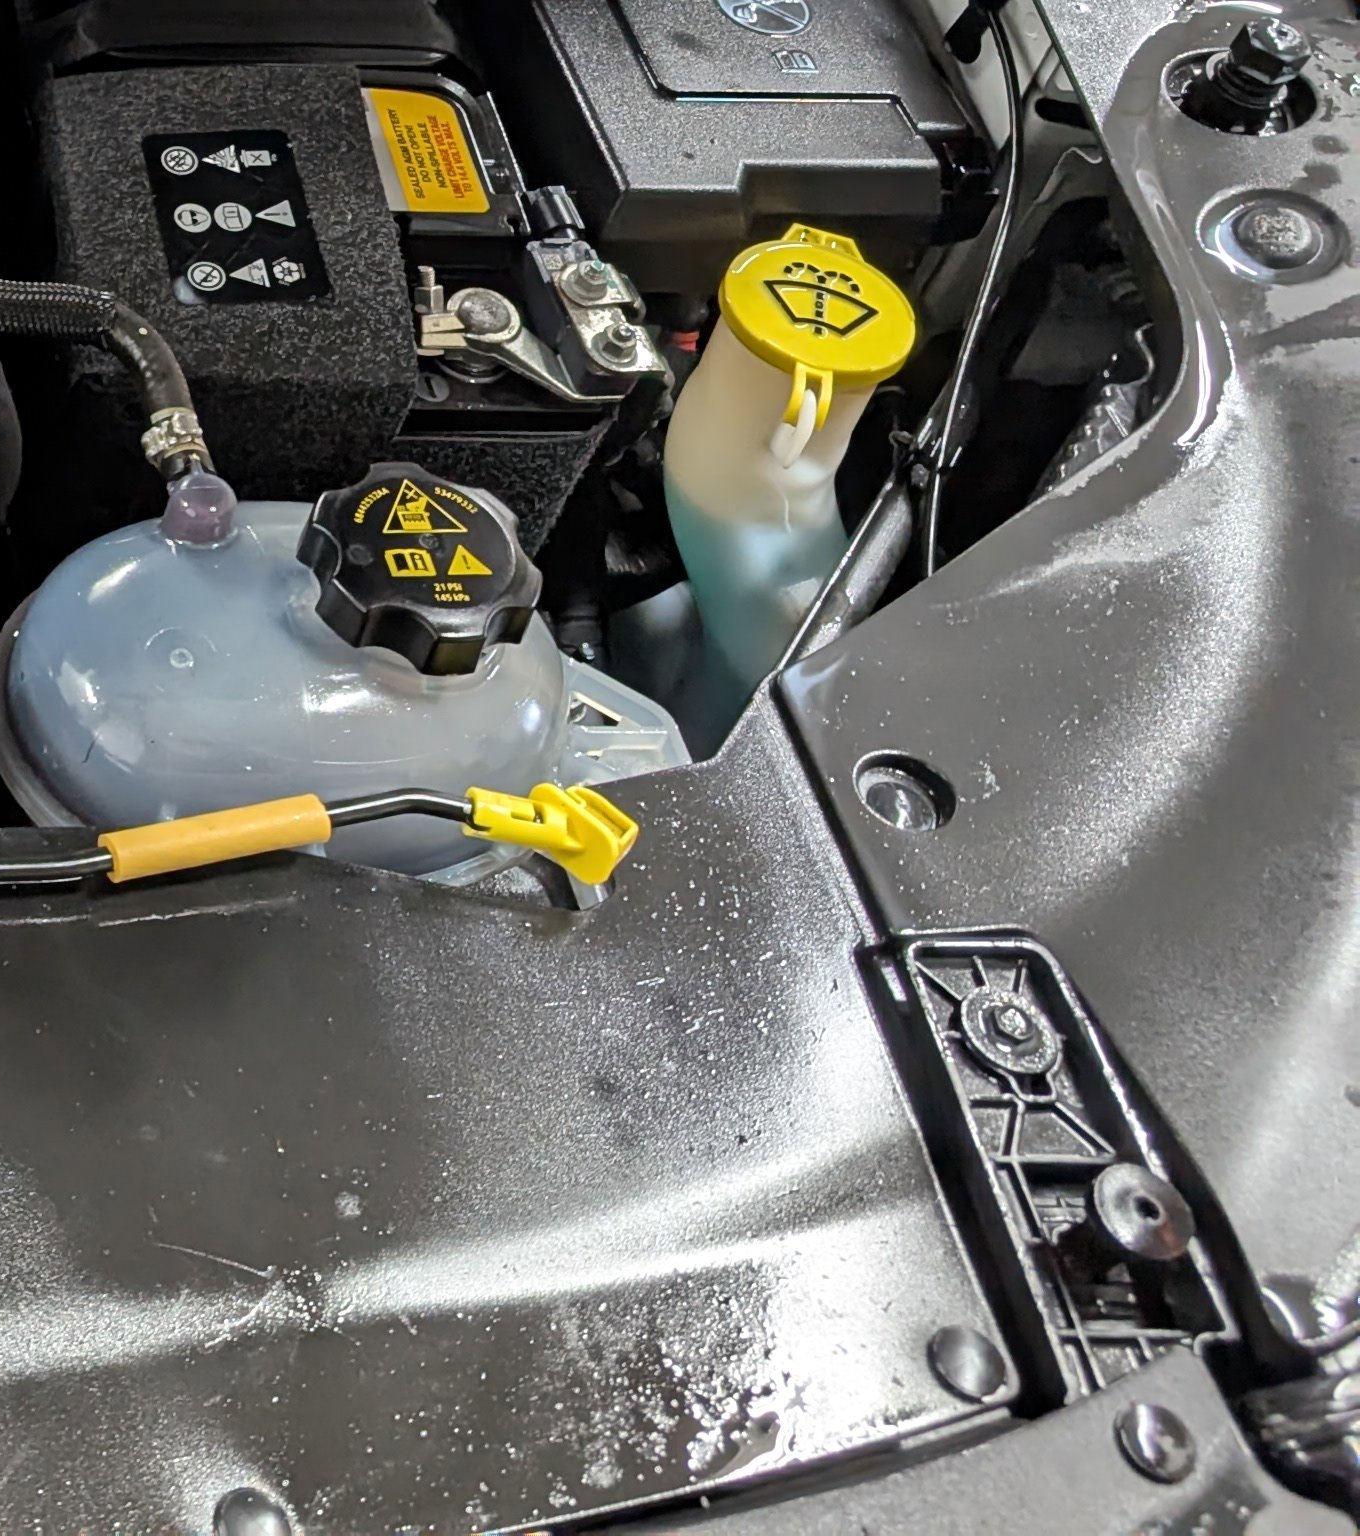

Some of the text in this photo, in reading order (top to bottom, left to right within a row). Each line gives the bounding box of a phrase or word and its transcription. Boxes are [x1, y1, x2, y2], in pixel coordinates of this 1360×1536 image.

[387, 108, 426, 199] SEALED AGM BATTERY
[413, 151, 427, 169] NOT
[416, 122, 449, 189] NON-SPILLABLE
[426, 114, 465, 199] LIMIT CHARGE VOLTAGE
[447, 141, 463, 165] VOLTS
[419, 169, 432, 183] DO
[456, 165, 469, 181] 14.4
[461, 182, 473, 193] TO
[447, 582, 463, 592] PSI
[452, 593, 471, 602] kPa
